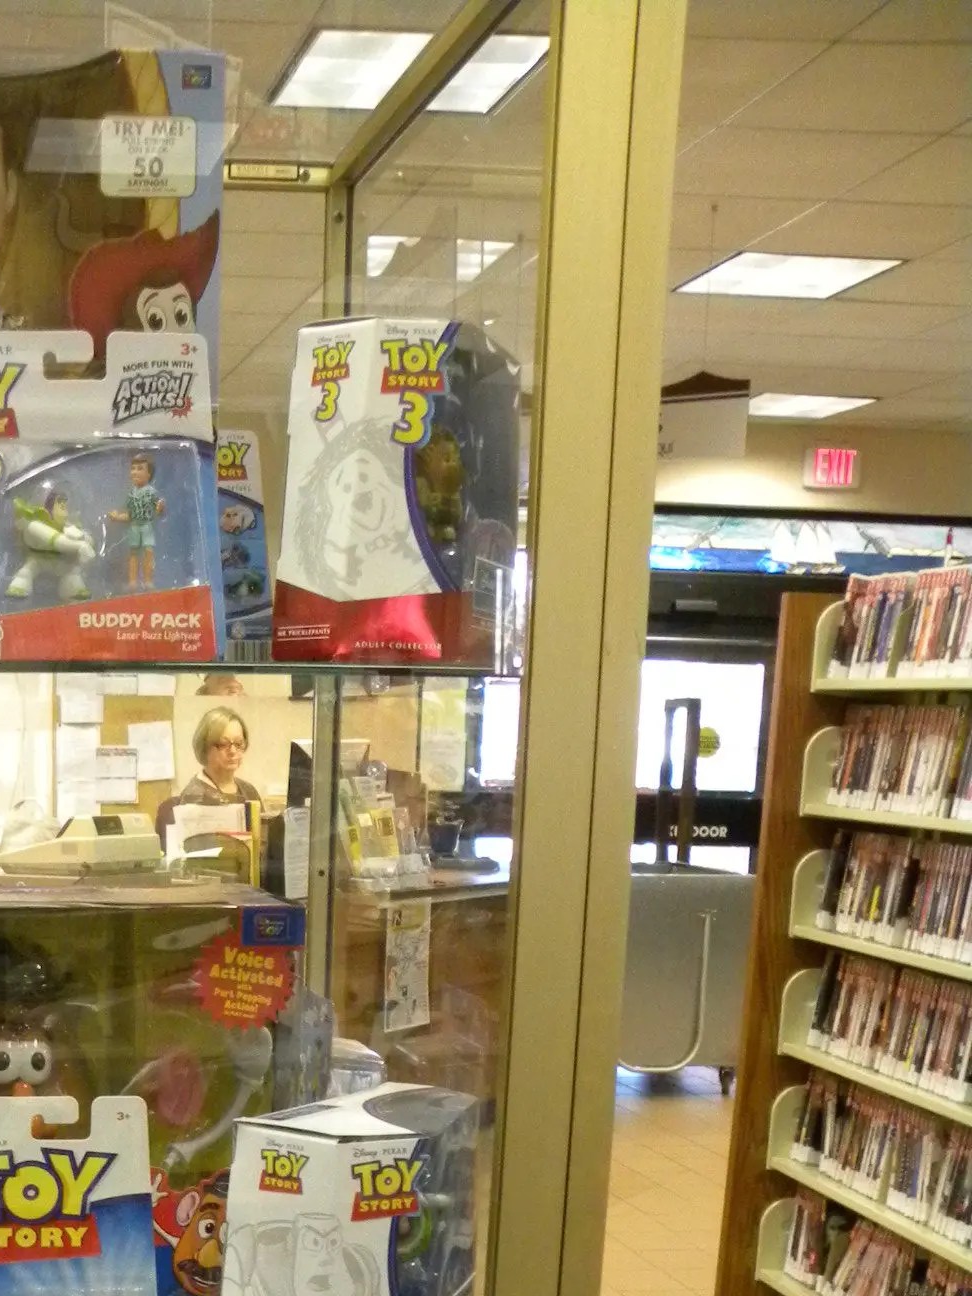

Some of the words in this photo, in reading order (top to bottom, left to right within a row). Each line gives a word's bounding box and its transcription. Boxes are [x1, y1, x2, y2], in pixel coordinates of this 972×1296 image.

[114, 120, 146, 137] TRY
[132, 156, 165, 178] 50
[180, 342, 199, 356] 3+
[312, 339, 356, 370] TOY
[380, 338, 449, 374] TOY
[122, 360, 149, 373] MORE
[151, 360, 169, 369] FUN
[171, 360, 193, 370] WITH
[387, 374, 441, 389] STORY
[314, 380, 341, 423] 3
[391, 389, 430, 447] 3
[813, 447, 858, 486] EXIT
[78, 612, 144, 629] BUDDY
[150, 612, 202, 629] PACK
[224, 945, 276, 971] Voice
[209, 963, 284, 988] Activated
[260, 1148, 310, 1179] TOY
[263, 1175, 300, 1191] STORY
[350, 1157, 425, 1197] TOY
[359, 1196, 415, 1213] STORY
